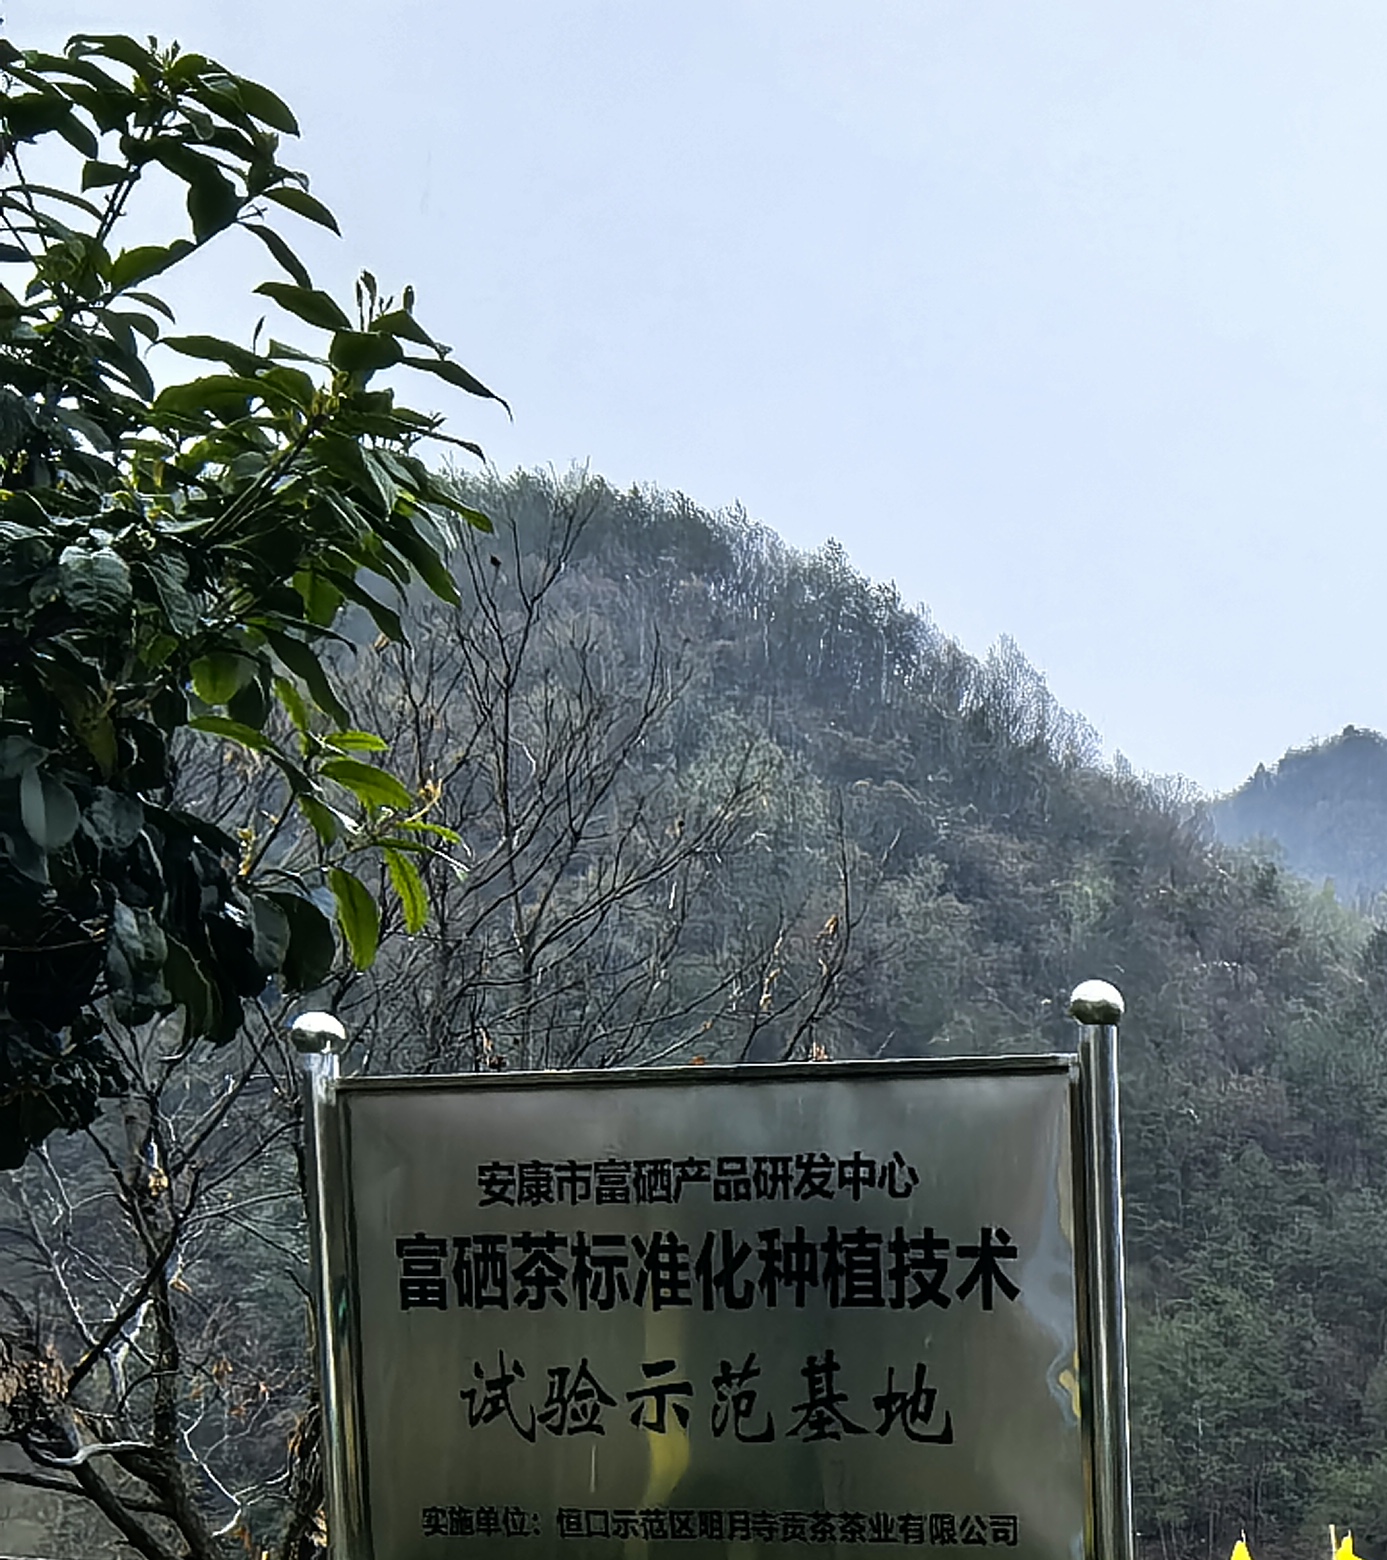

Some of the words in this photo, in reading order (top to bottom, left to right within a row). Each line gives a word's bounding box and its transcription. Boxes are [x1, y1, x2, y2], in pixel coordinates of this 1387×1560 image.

[478, 1152, 919, 1207] 安康市富硒产品研发中心
[396, 1228, 1020, 1312] 富硒茶标准化种植技术
[460, 1351, 953, 1444] 试验示范基地
